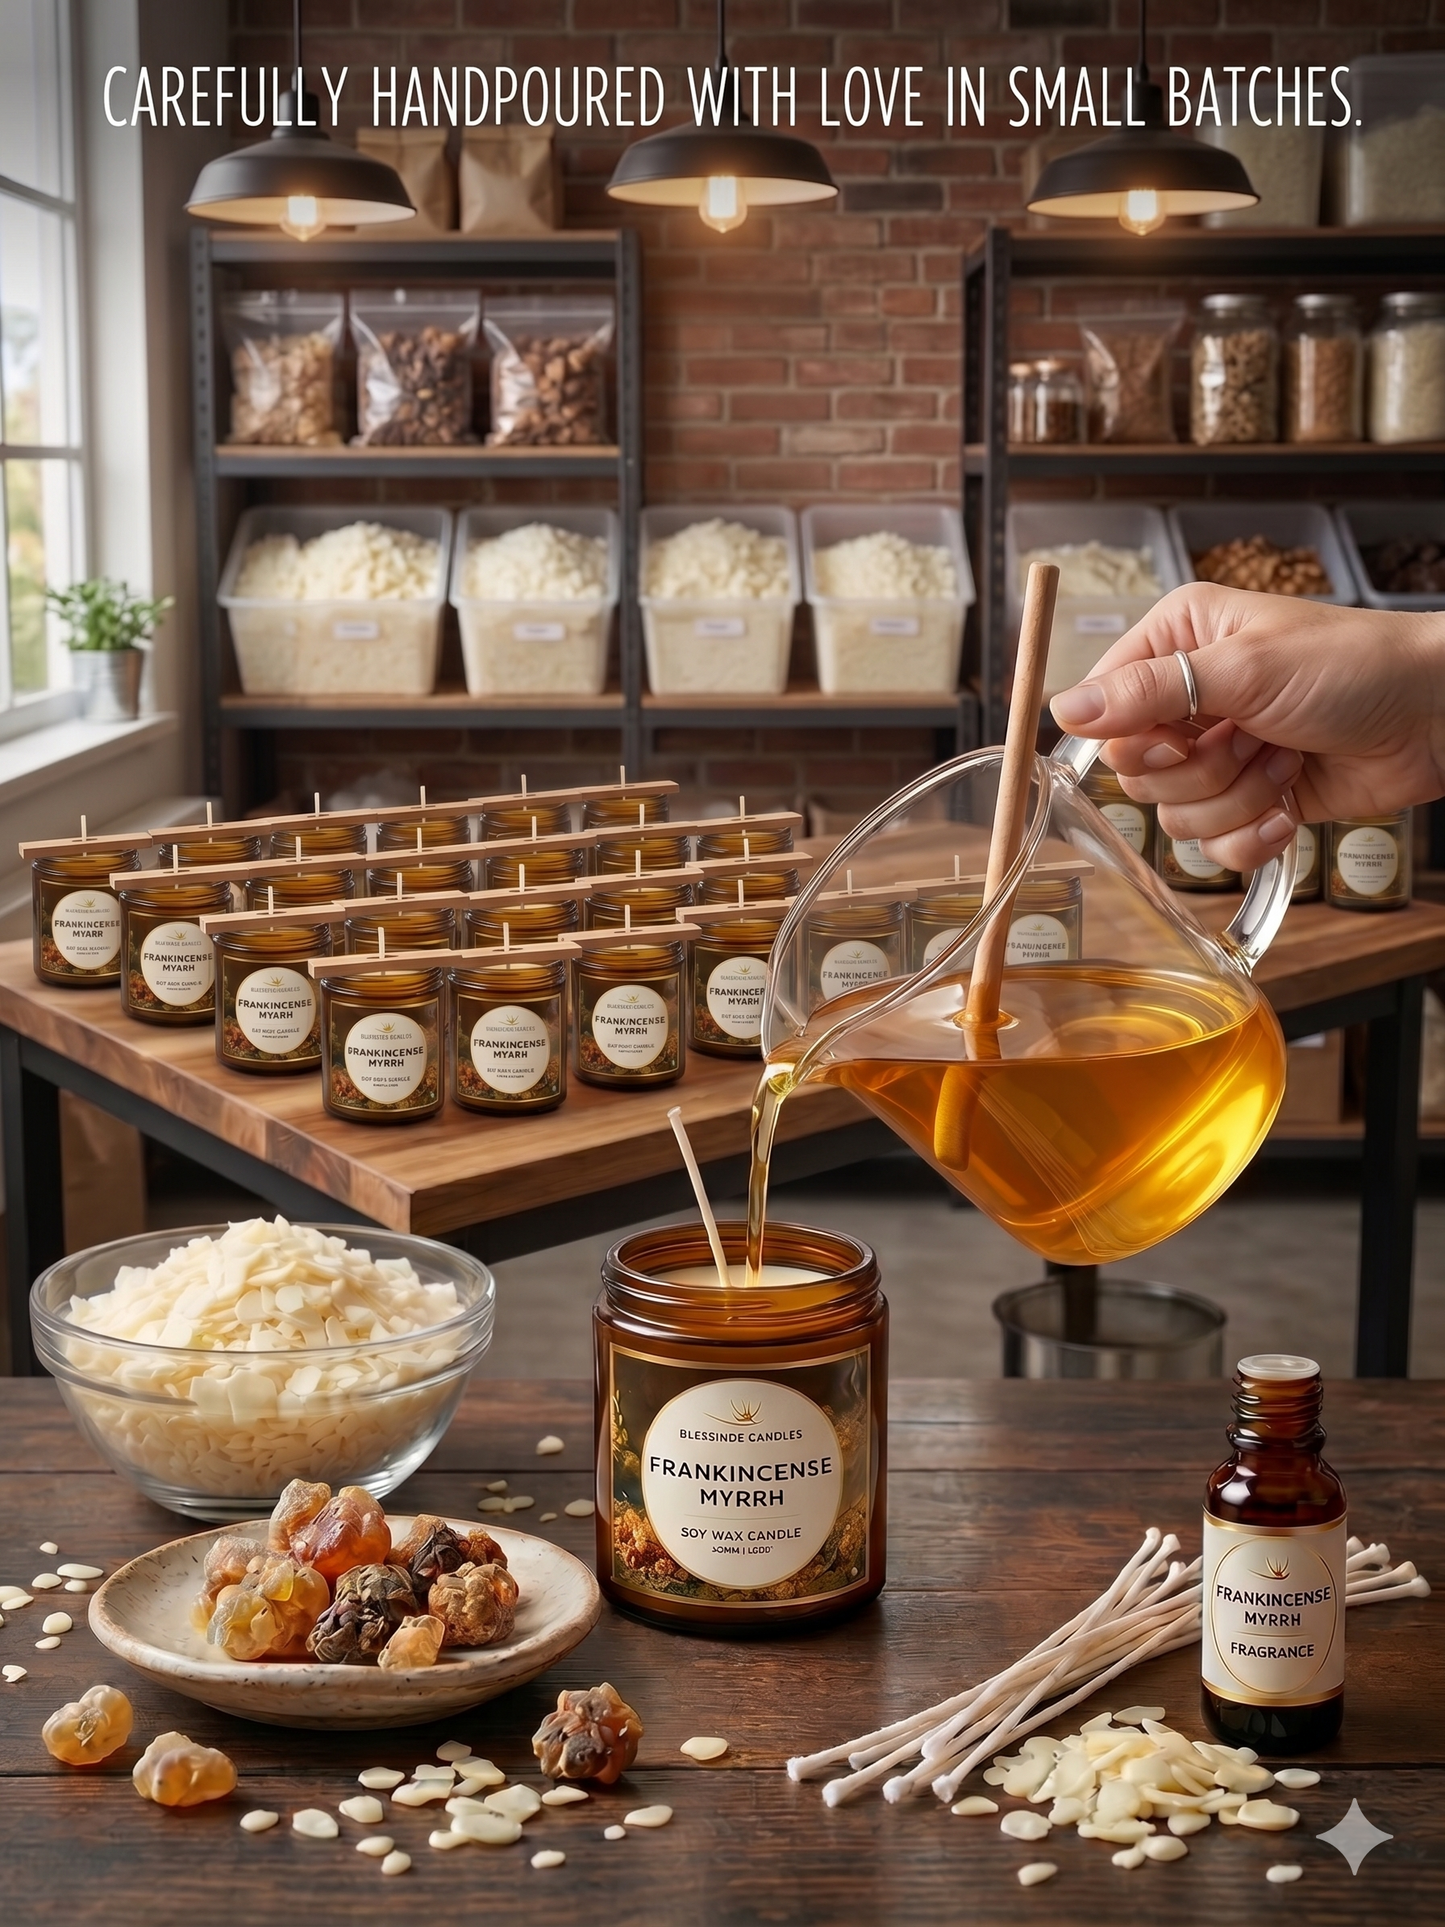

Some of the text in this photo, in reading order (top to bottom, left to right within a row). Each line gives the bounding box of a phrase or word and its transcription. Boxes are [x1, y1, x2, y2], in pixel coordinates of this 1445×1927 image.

[238, 998, 313, 1010] FRANKINCENSE
[614, 1027, 648, 1035] MYRRH
[473, 1038, 546, 1049] FRANKINCENSE
[368, 1059, 404, 1067] MYRRH
[679, 1429, 803, 1443] BLESSINDE CANDLES
[649, 1456, 833, 1482] FRANKINCENSE
[700, 1488, 785, 1507] MYRRH
[680, 1527, 802, 1541] SOY WAX CANDLE
[1216, 1584, 1332, 1607] FRANKINCENSE
[1244, 1611, 1301, 1626] MYRRH
[1230, 1641, 1315, 1659] FRAGRANCE
